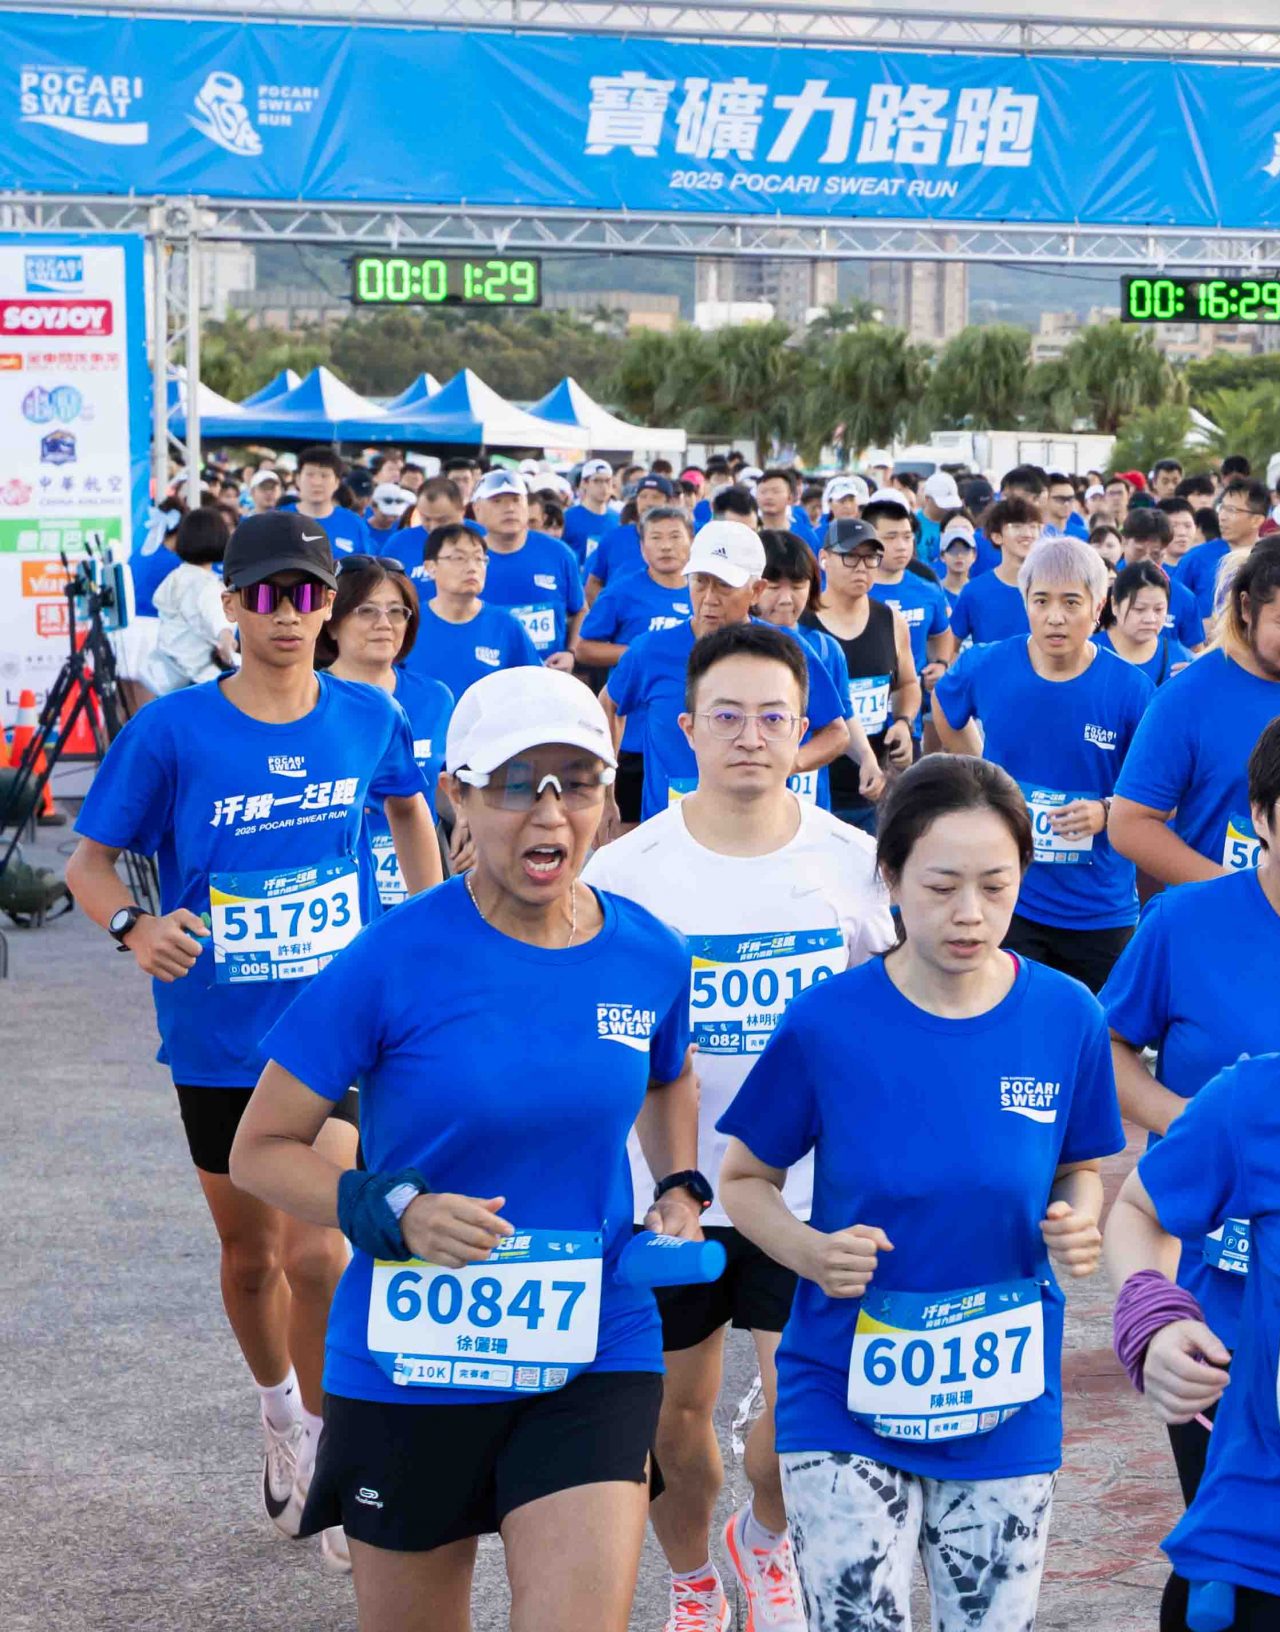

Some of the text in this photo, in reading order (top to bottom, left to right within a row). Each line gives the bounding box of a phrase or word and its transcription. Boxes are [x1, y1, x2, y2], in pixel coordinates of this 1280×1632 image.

[20, 73, 143, 98] POCARI
[258, 85, 319, 98] POCARI
[21, 94, 131, 118] SWEAT
[258, 99, 312, 112] SWEAT
[258, 113, 292, 126] RUN
[583, 71, 1039, 167] 寶礦力路跑
[669, 170, 958, 198] 2025 POCARI SWEAT RUN
[3, 306, 107, 329] SOYJOY
[39, 475, 122, 493] 中華航空
[269, 756, 305, 765] POCARI
[269, 762, 303, 772] SWEAT
[210, 777, 360, 827] 汗我一起跑
[235, 810, 348, 836] 2025 POCARI SWEAT RUN
[223, 892, 351, 941] 51793
[241, 963, 270, 975] 005
[597, 1007, 656, 1024] POCARI
[597, 1021, 652, 1036] SWEAT
[710, 1034, 740, 1046] 082
[1000, 1081, 1060, 1096] POCARI
[1000, 1093, 1054, 1107] SWEAT
[386, 1271, 586, 1331] 60847
[863, 1326, 1032, 1387] 60187
[417, 1365, 446, 1380] 10K
[895, 1424, 922, 1436] 10K
